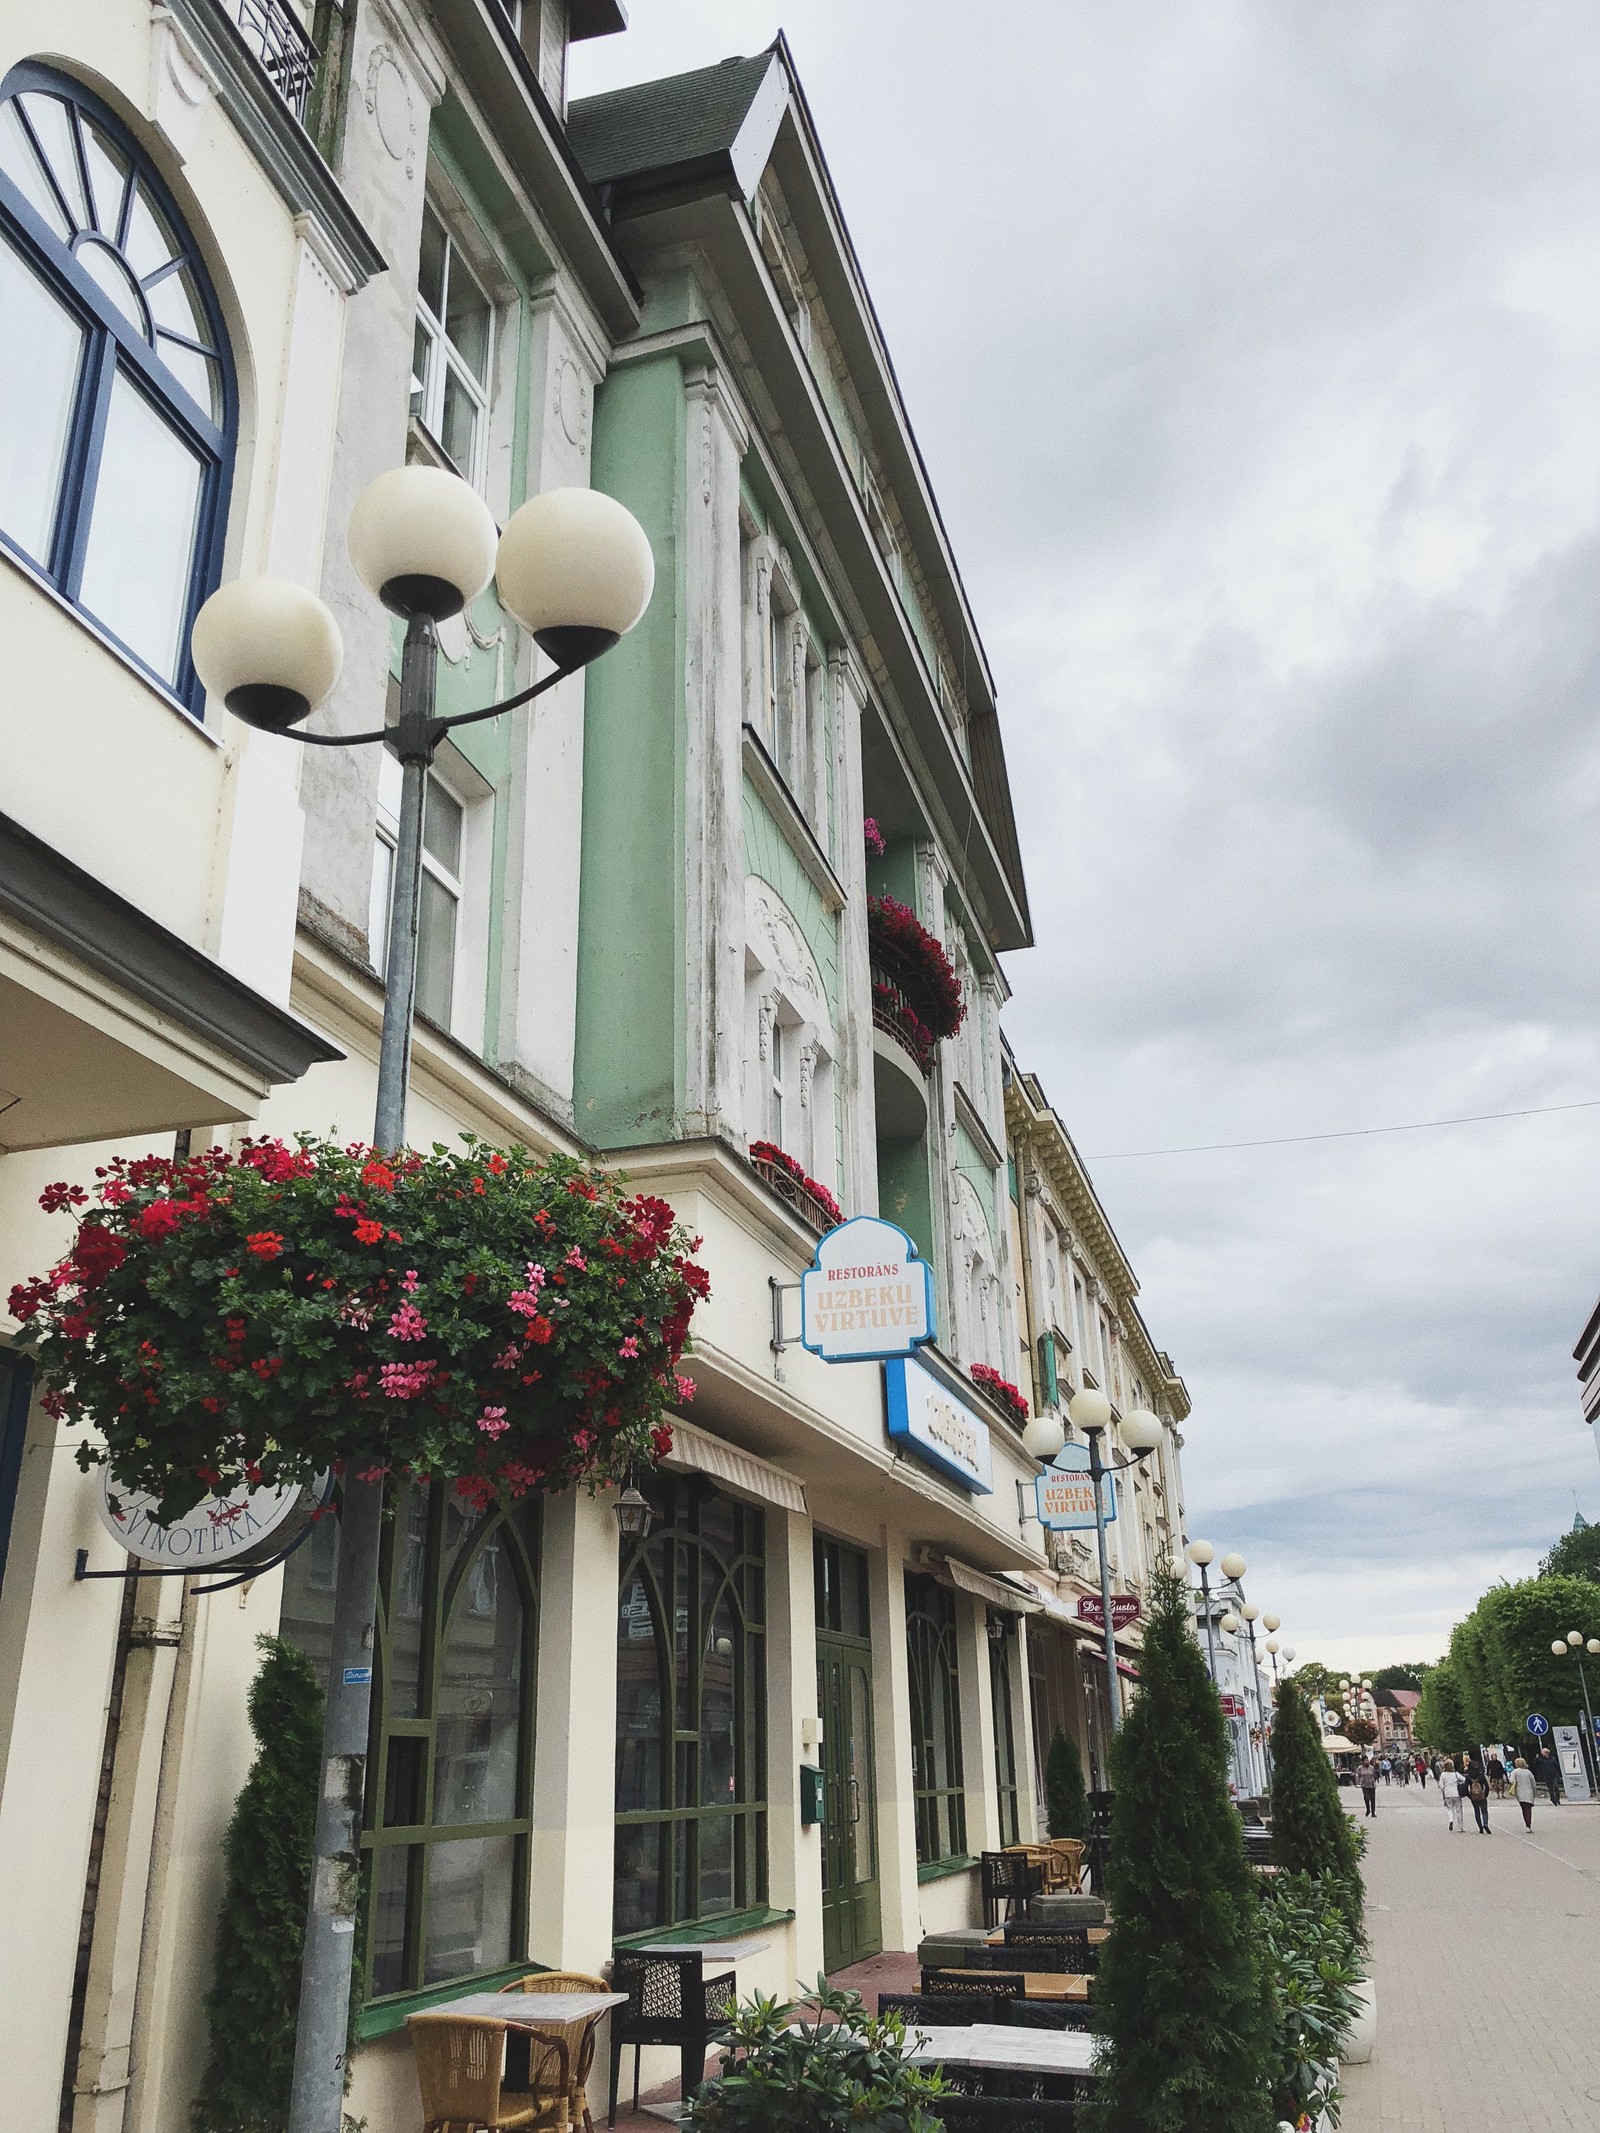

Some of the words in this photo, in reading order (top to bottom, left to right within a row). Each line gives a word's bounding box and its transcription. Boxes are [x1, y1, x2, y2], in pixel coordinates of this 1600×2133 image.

[827, 1261, 899, 1281] RESTORĀNS
[817, 1284, 913, 1311] UZBEKU
[814, 1306, 918, 1333] VIRTUVE
[1045, 1487, 1103, 1501] UZBEK
[126, 1508, 263, 1556] VINOTEKA
[1082, 1600, 1101, 1612] De
[1108, 1600, 1137, 1614] Gusto
